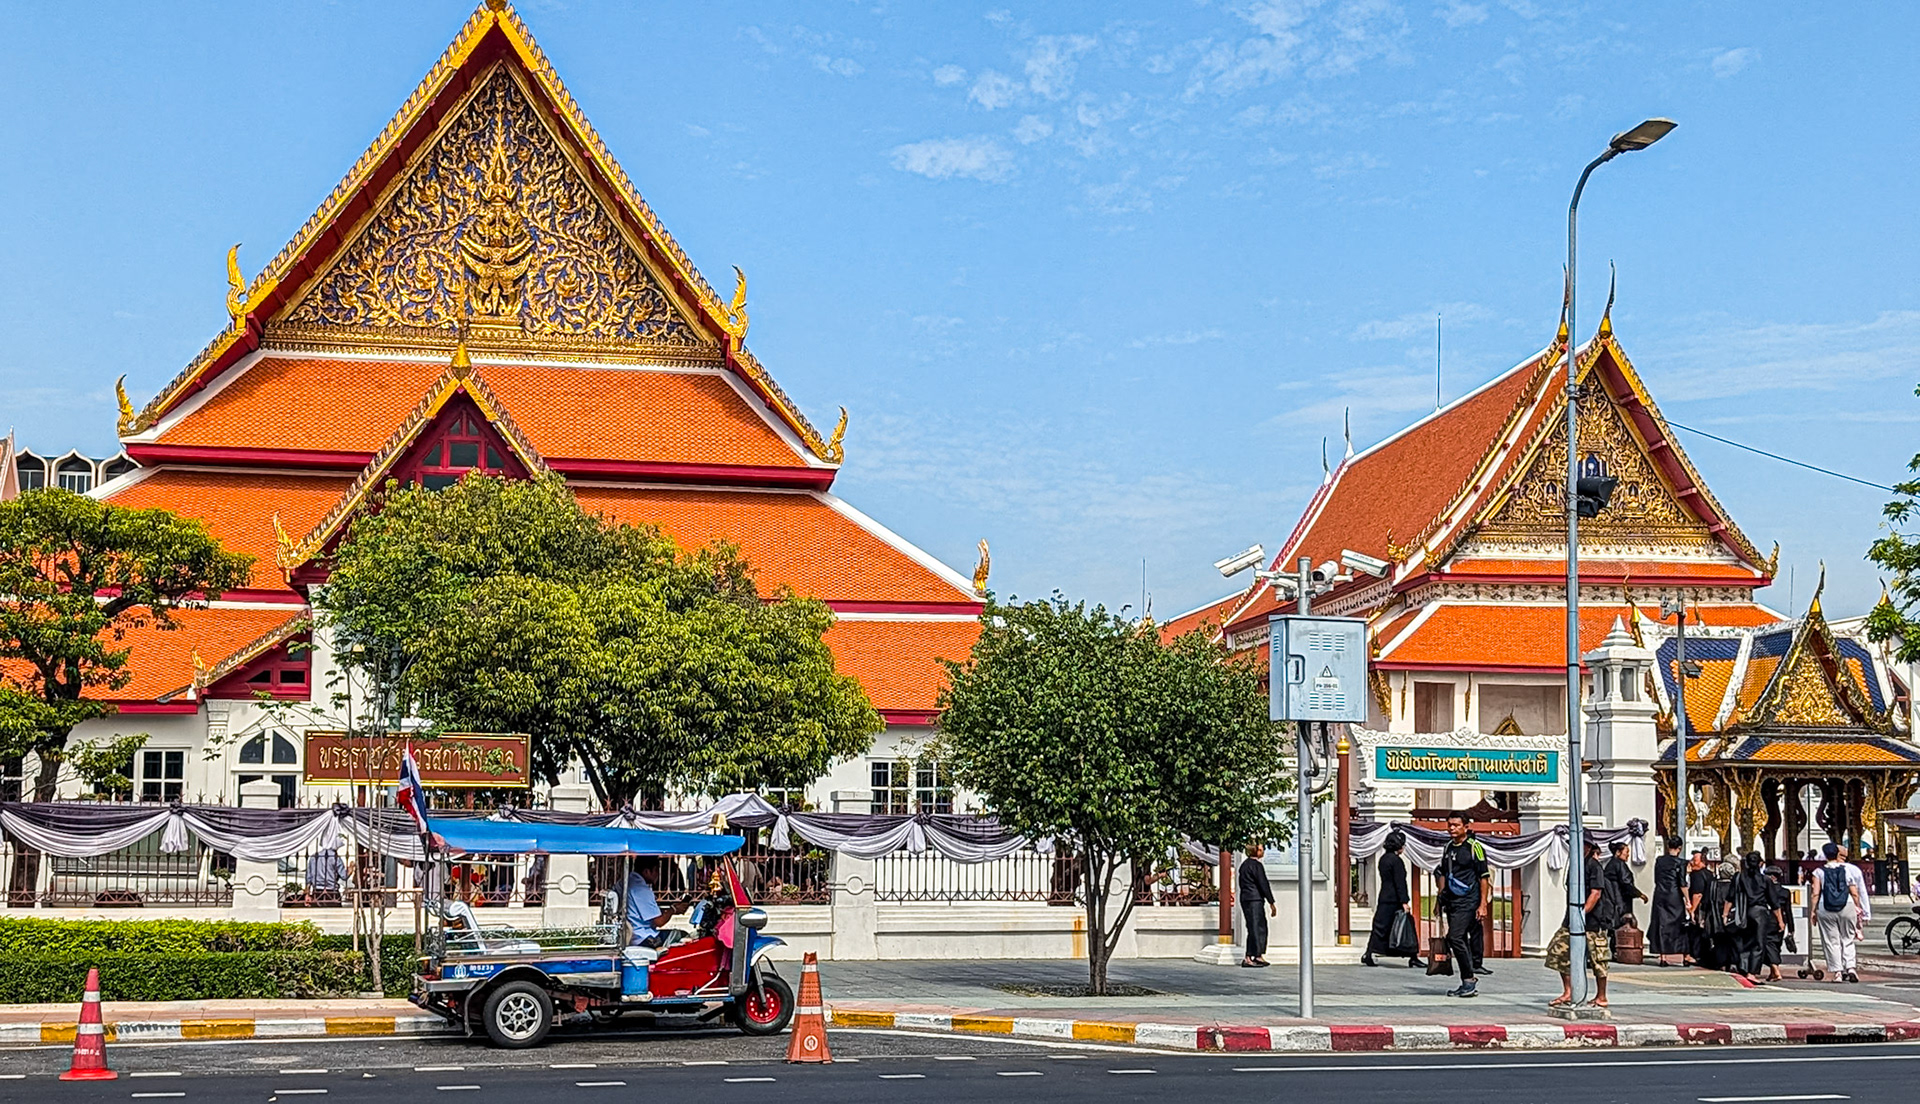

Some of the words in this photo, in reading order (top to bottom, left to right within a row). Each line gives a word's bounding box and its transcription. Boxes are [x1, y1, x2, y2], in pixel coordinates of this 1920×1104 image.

[319, 740, 514, 771] พระราชวังวรสถานมล
[1386, 750, 1548, 774] พิพิธภัณฑสถานแห่งชาติ
